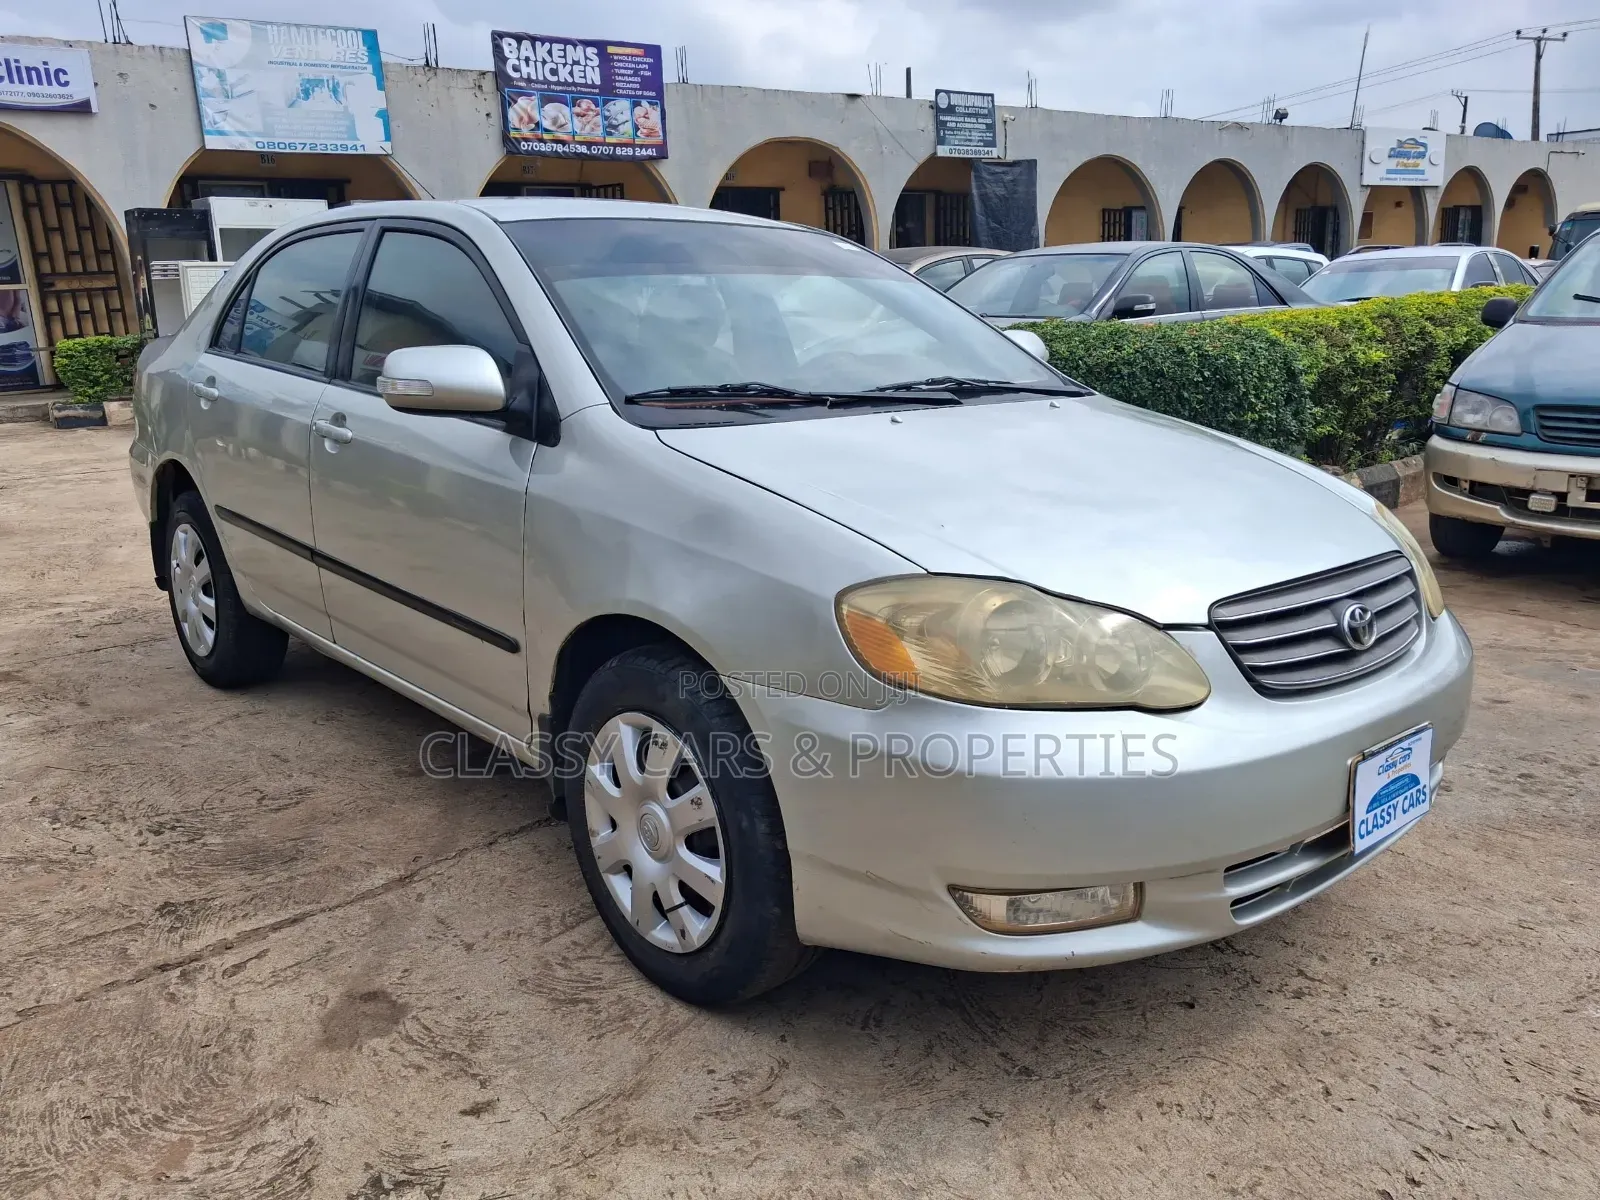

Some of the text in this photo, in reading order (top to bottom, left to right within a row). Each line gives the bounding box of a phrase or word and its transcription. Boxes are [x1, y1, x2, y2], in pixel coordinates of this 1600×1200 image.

[270, 46, 370, 64] VENTRES
[502, 37, 600, 67] BAKEMS
[505, 59, 602, 85] CHICKEN
[255, 141, 367, 152] 08067233941
[591, 145, 614, 155] 0707
[635, 147, 657, 156] 2441
[260, 153, 276, 165] B16
[1378, 759, 1398, 776] Classy
[1359, 800, 1400, 840] CLASSY
[1402, 784, 1427, 815] CARS
